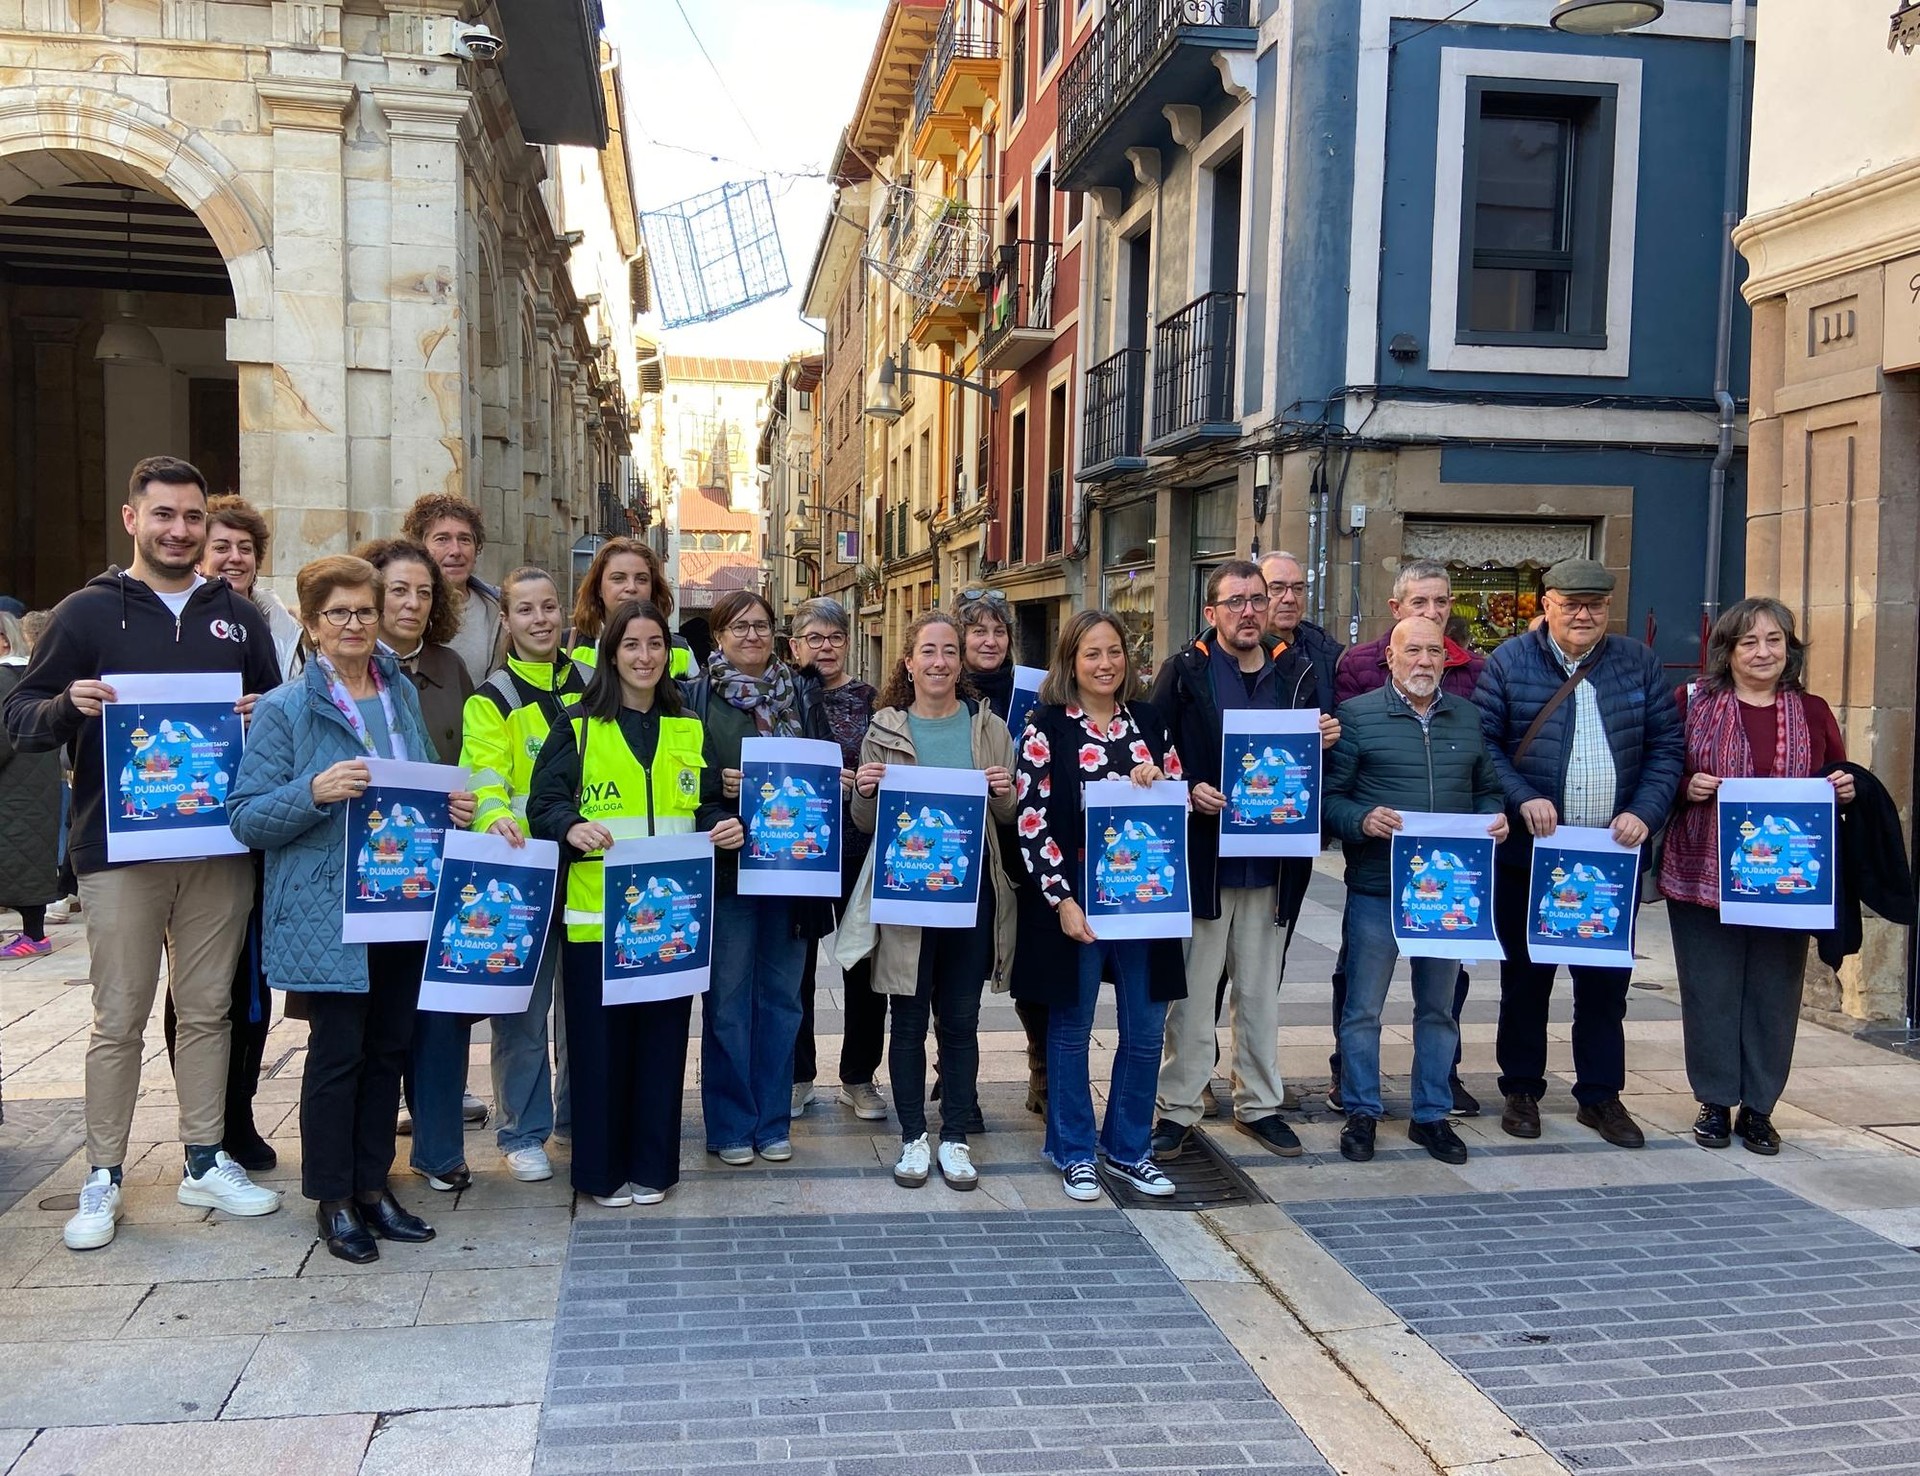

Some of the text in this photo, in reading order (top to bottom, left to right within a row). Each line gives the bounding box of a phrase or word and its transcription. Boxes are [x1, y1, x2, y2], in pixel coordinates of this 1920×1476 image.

[134, 783, 186, 794] DURANGO
[1241, 798, 1279, 806] DURANGO
[760, 831, 800, 839] DURANGO
[895, 861, 935, 870] DURANGO
[369, 867, 410, 876] DURANGO
[1741, 866, 1784, 875] DURANGO
[1105, 874, 1143, 883] DURANGO
[1411, 902, 1448, 911] DURANGO
[1548, 910, 1586, 919] DURANGO
[626, 934, 667, 945] DURANGO
[454, 939, 498, 950] DURANGO
